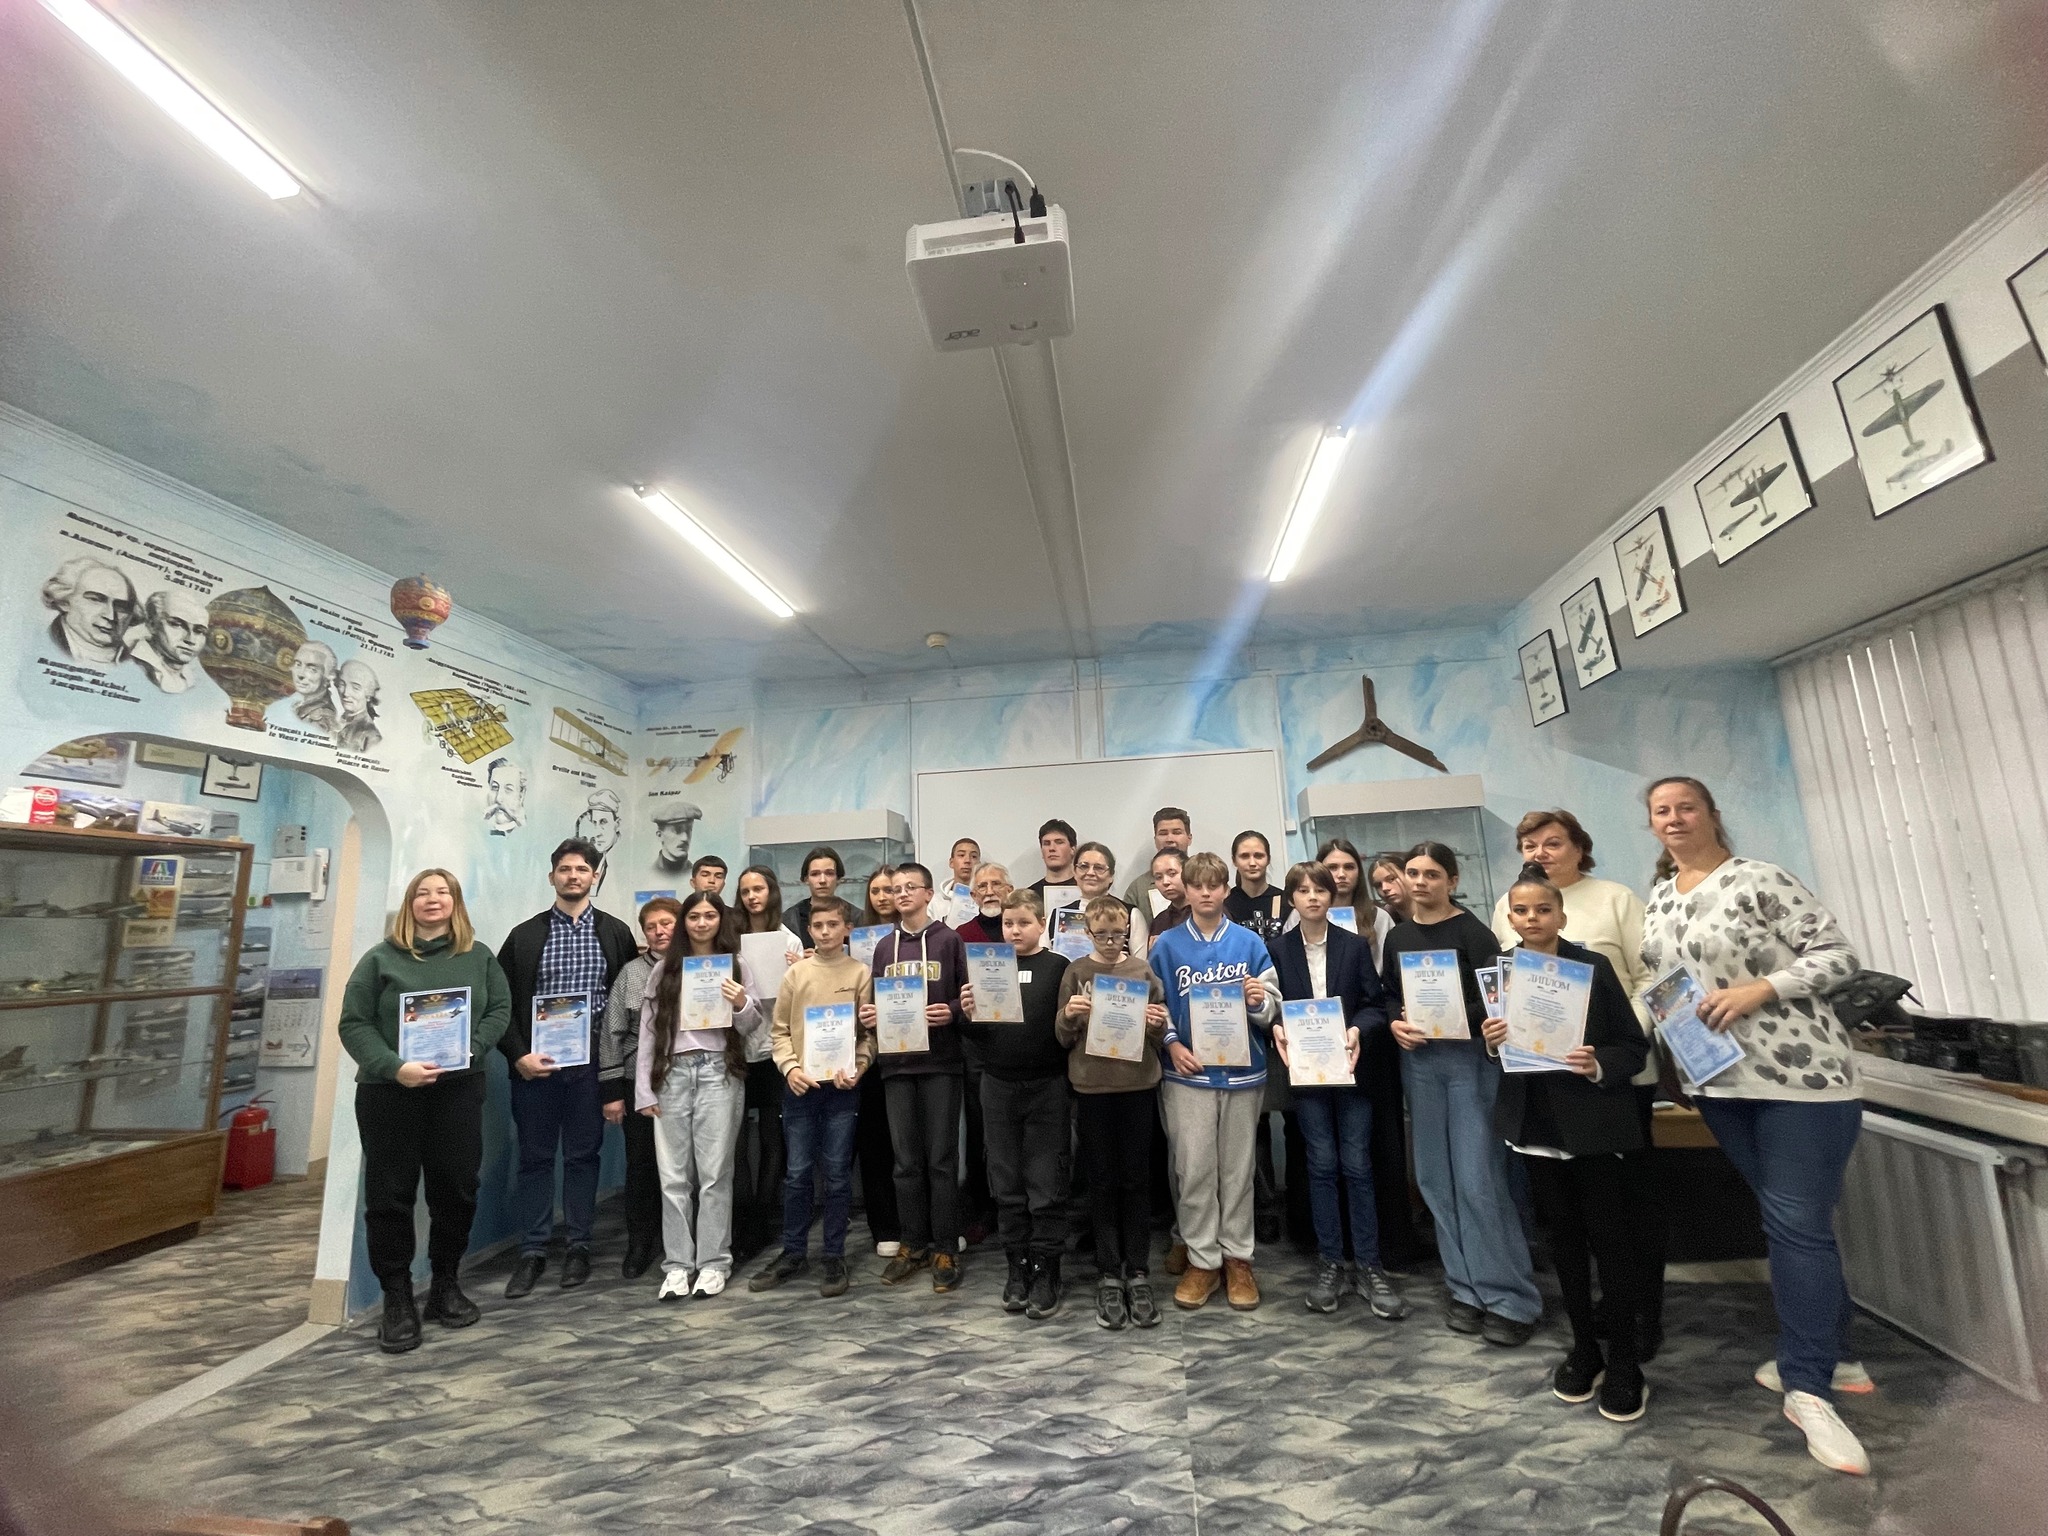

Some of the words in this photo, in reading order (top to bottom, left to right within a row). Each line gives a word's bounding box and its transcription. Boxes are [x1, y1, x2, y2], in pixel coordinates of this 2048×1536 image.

[944, 328, 981, 341] acer
[1175, 961, 1249, 991] Boston
[1415, 970, 1445, 979] ДИПЛОМ
[1527, 974, 1571, 991] ДИПЛОМ
